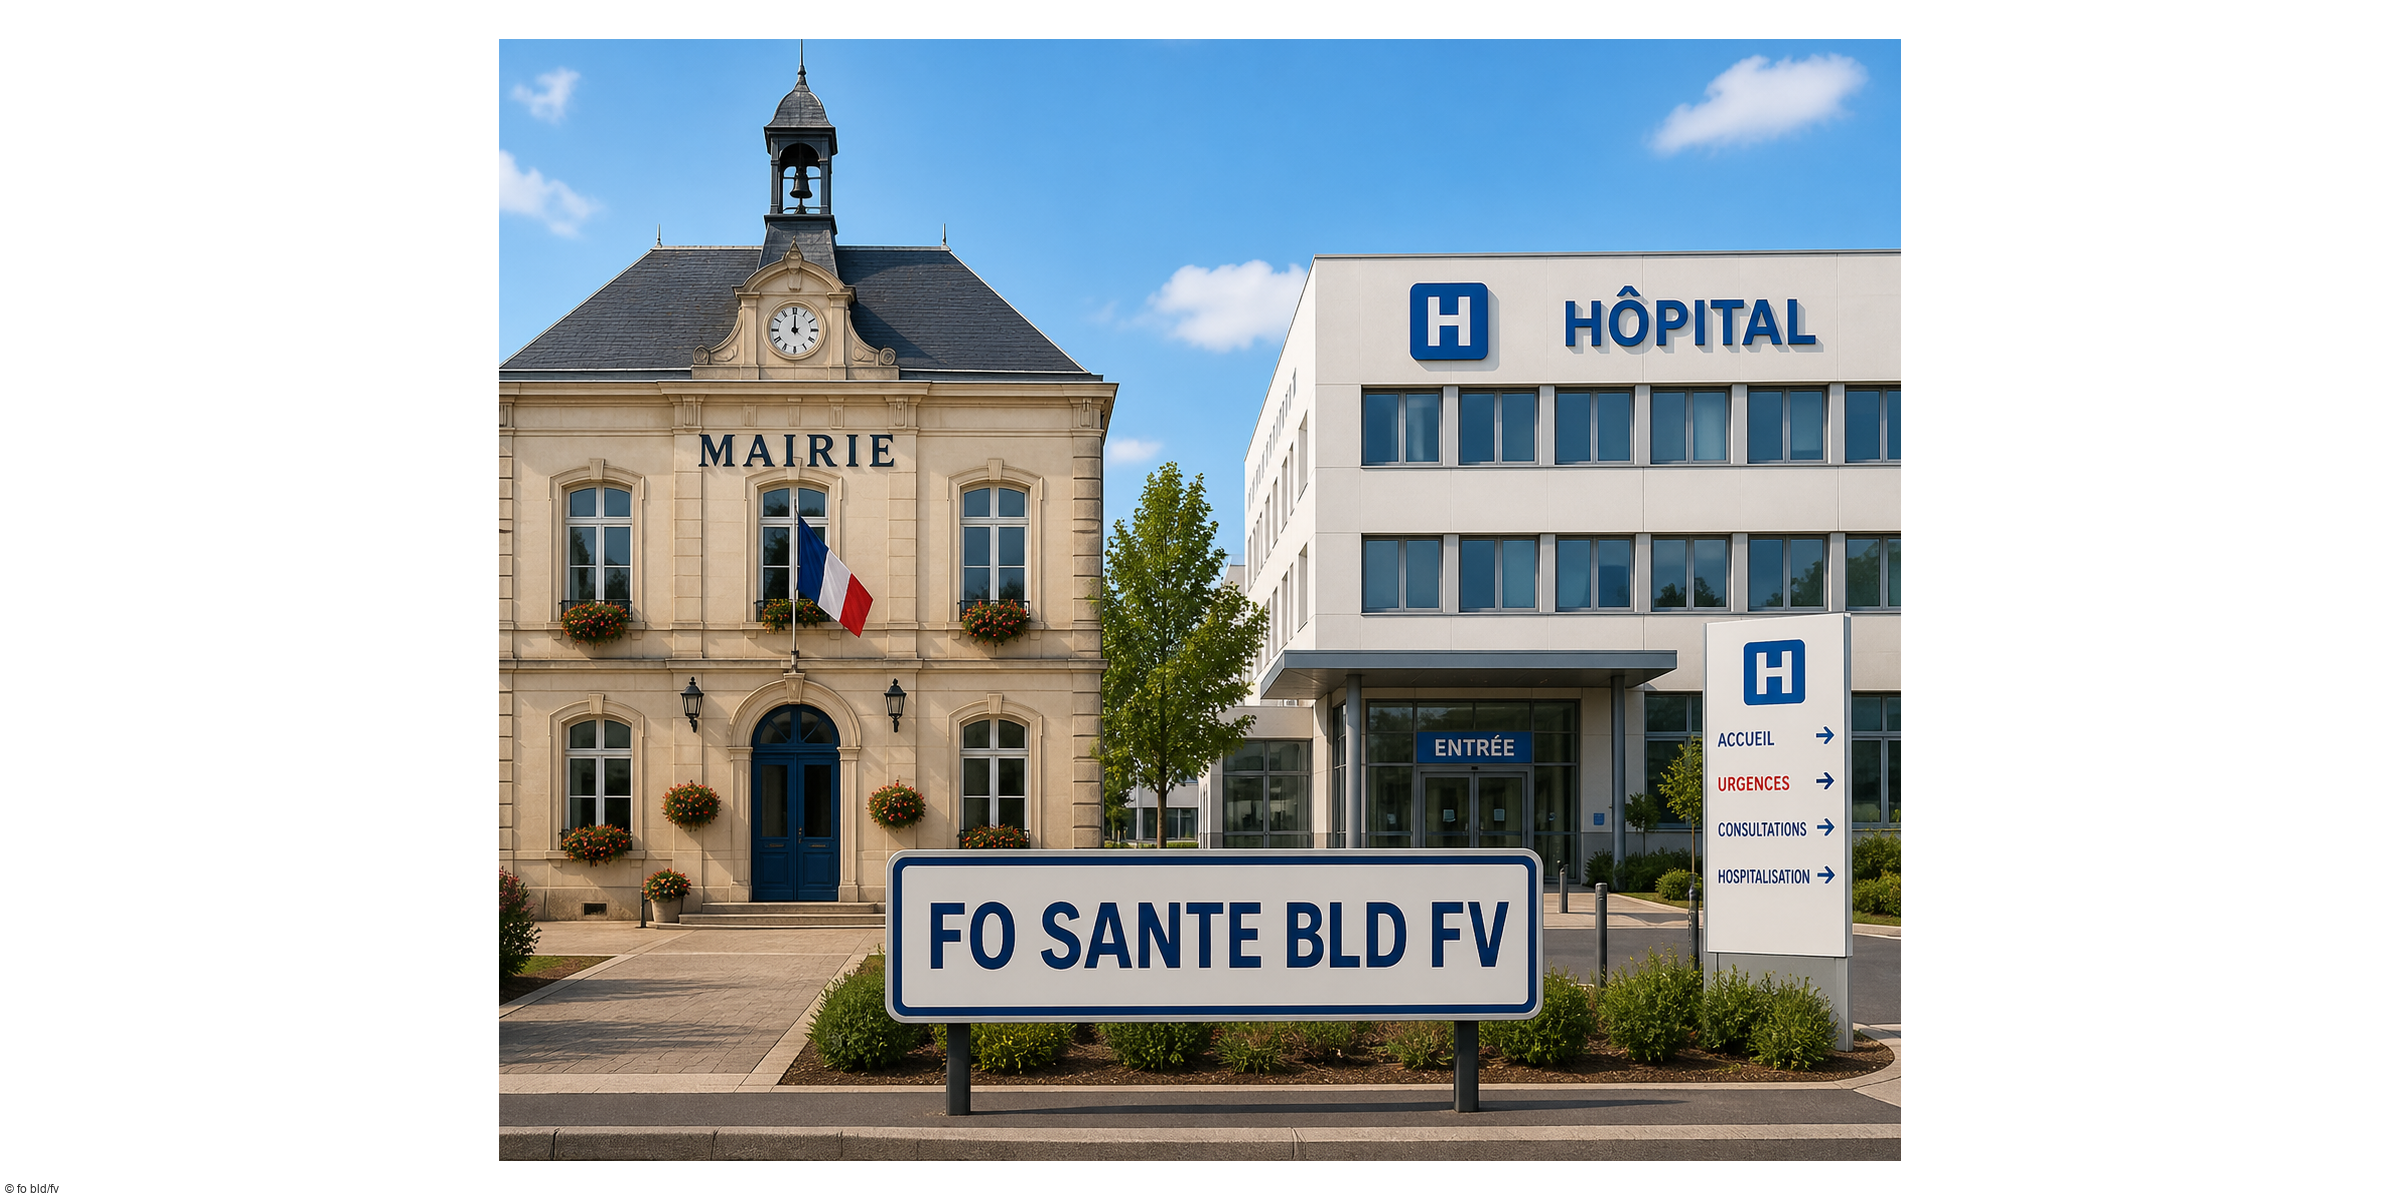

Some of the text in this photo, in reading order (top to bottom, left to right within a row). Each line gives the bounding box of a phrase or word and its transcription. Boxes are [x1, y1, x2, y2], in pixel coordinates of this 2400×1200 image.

[1427, 296, 1471, 347] H
[1565, 285, 1816, 347] HÔPITAL
[698, 433, 895, 468] MAIRIE
[1756, 650, 1793, 695] H
[1434, 734, 1515, 757] ENTRÉE
[1717, 730, 1775, 747] ACCUEIL
[1717, 775, 1790, 792] URGENCES
[1718, 822, 1807, 837] CONSULTATIONS
[1718, 869, 1810, 884] HOSPITALISATION
[930, 901, 1509, 970] FO SANTE BLD FV
